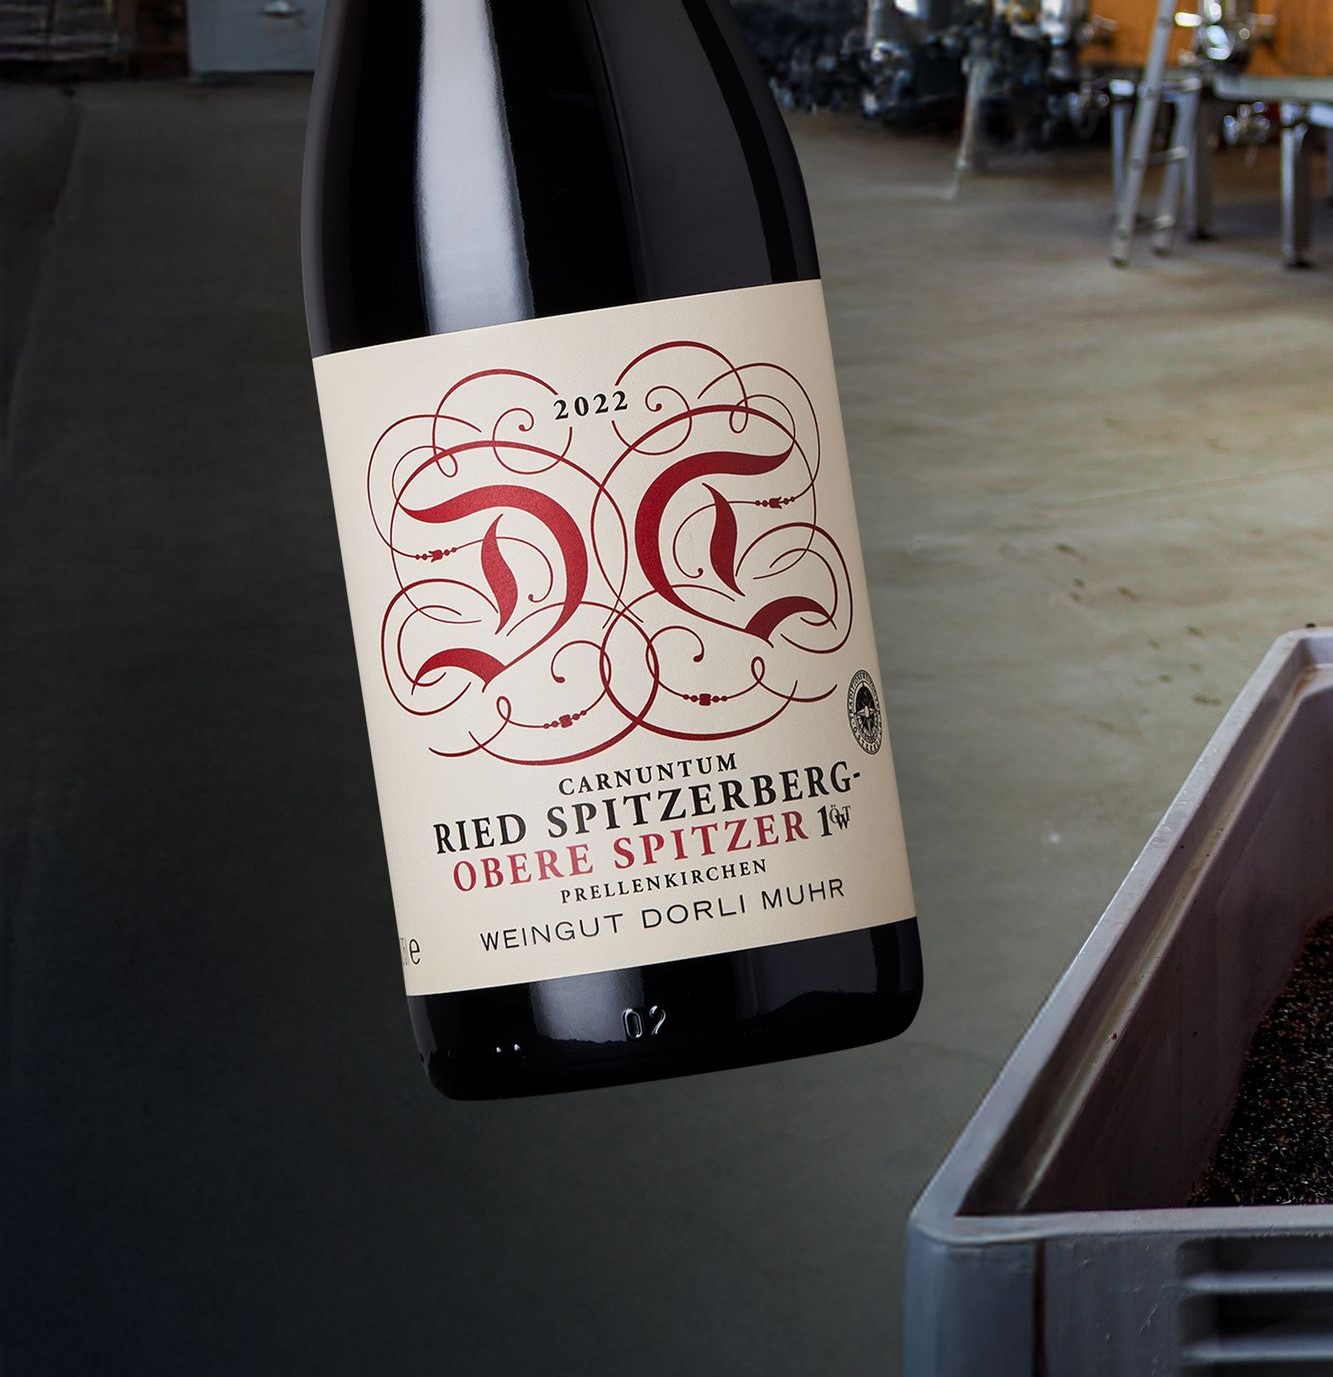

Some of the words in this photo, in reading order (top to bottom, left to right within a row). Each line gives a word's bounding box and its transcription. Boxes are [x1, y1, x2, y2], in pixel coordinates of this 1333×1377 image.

[553, 390, 628, 420] 2022
[558, 752, 738, 796] CARNUNTUM
[433, 813, 527, 855] RIED
[546, 760, 862, 839] SPITZERBERG-
[453, 848, 594, 893] OBERE
[612, 810, 810, 870] SPITZER
[559, 858, 768, 905] PRELLENKIRCHEN
[479, 912, 624, 952] WEINGUT
[640, 893, 746, 930] DORLI
[760, 878, 845, 911] MUHR
